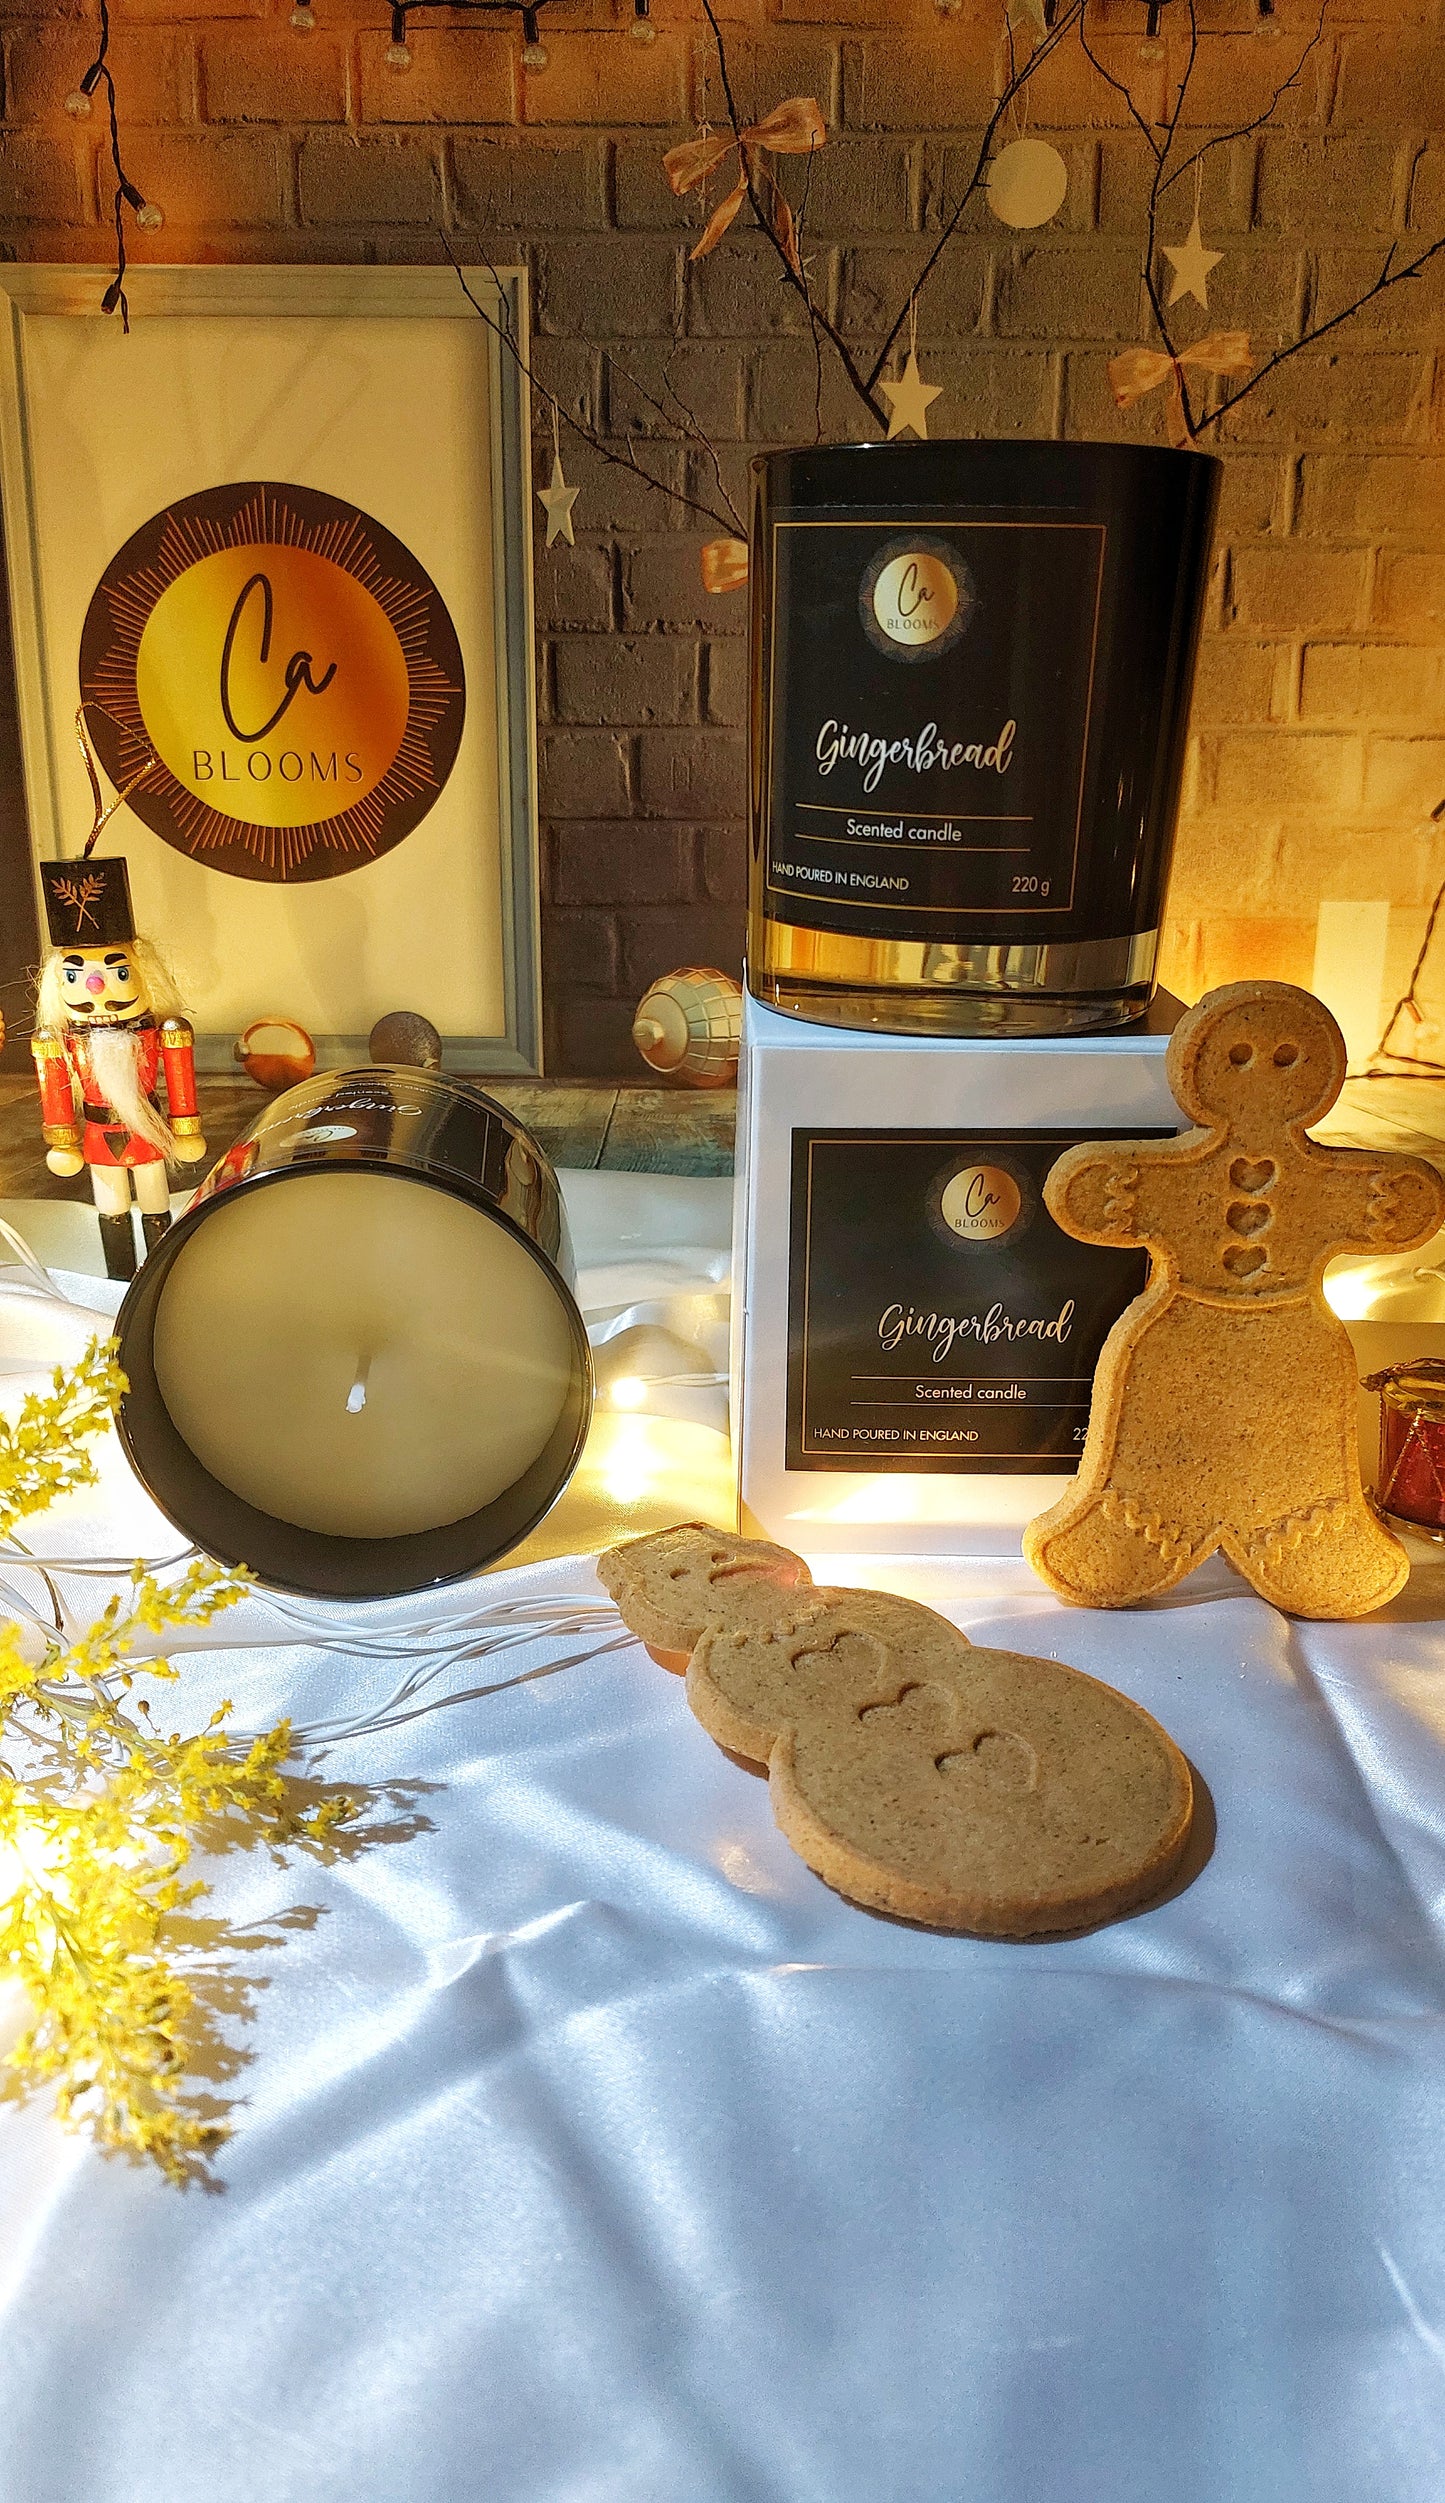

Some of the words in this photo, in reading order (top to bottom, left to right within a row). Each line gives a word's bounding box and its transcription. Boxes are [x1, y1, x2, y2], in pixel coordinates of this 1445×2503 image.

[898, 563, 935, 617] Ca
[220, 573, 338, 743] Ca
[193, 750, 364, 783] BLOOMS
[815, 719, 1017, 793] Gingerbread
[847, 819, 903, 840] Scented
[908, 822, 962, 842] candle
[772, 861, 795, 877] HAND
[796, 866, 833, 883] POURED
[835, 872, 847, 885] IN
[850, 873, 909, 891] ENGLAND
[1012, 876, 1039, 892] 220
[1041, 880, 1050, 895] g
[966, 1173, 1001, 1217] Ca
[954, 1219, 1005, 1228] BLOOMS
[878, 1299, 1075, 1362] Gingerbread
[915, 1384, 973, 1399] Scented
[977, 1385, 1027, 1400] candle
[813, 1427, 850, 1440] HAND
[852, 1428, 900, 1441] POURED
[902, 1430, 917, 1441] IN
[919, 1430, 979, 1442] ENGLAND
[1072, 1427, 1089, 1441] 22
